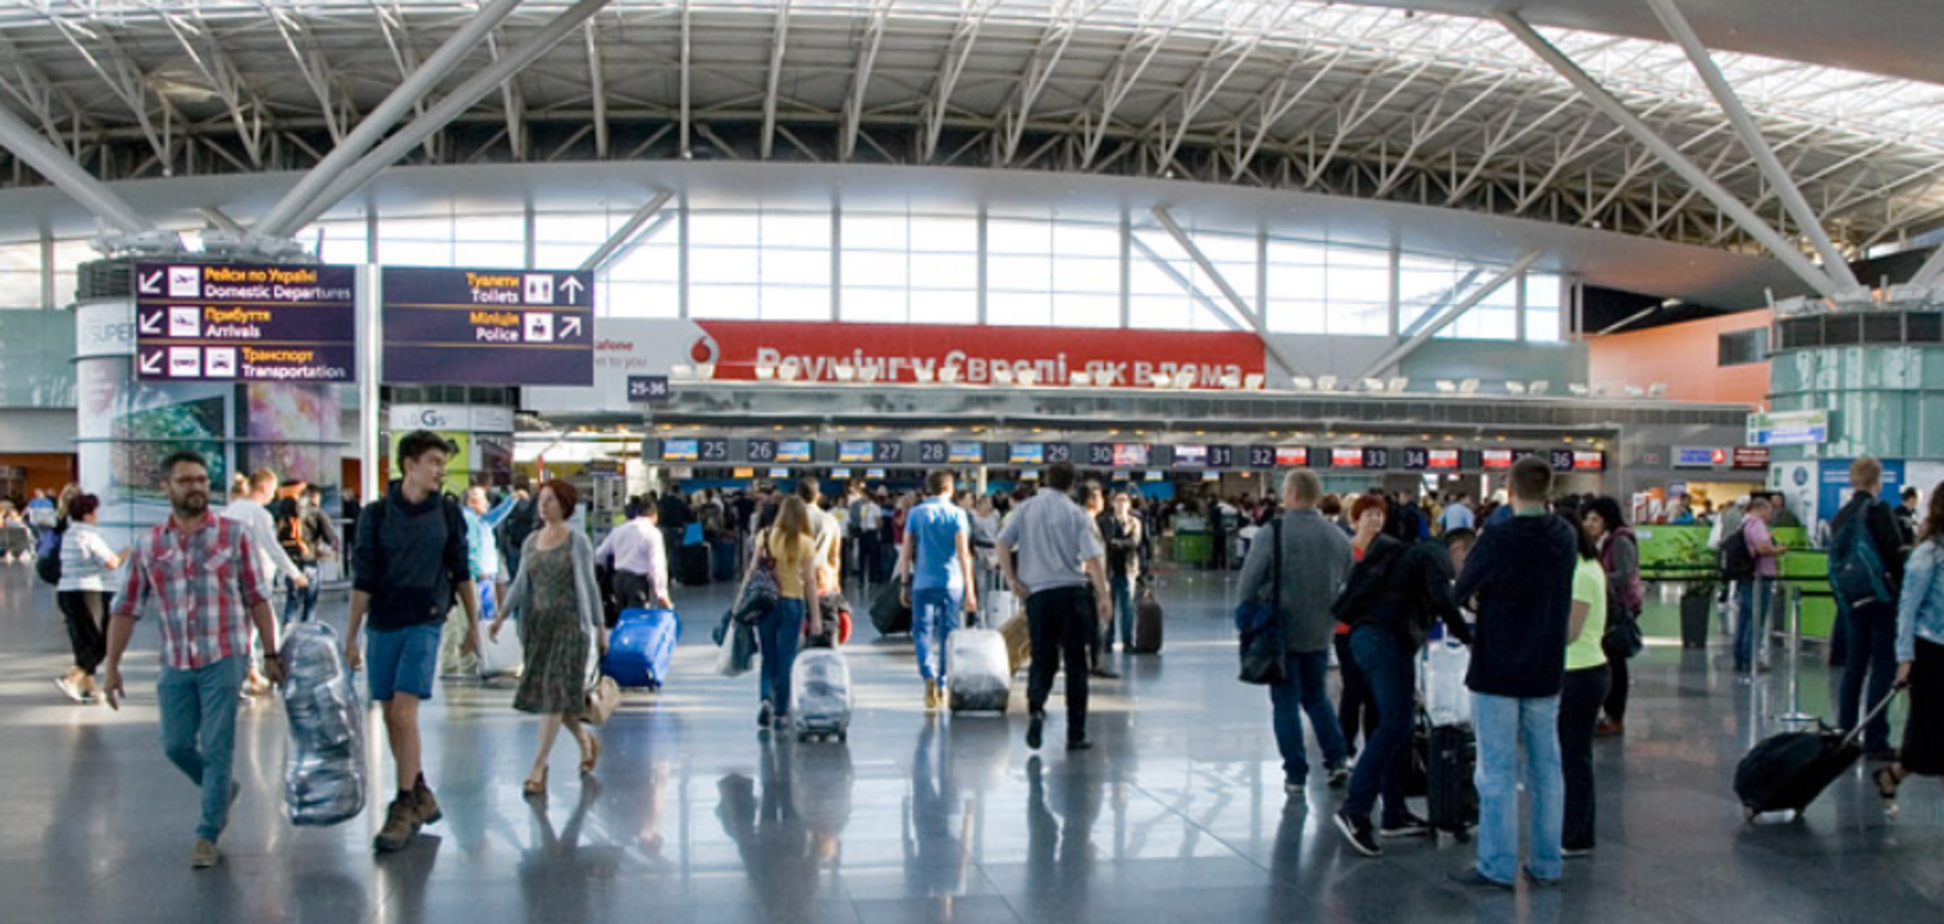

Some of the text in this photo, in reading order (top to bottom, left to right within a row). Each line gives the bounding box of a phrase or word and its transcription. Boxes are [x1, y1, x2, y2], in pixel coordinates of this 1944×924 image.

[205, 267, 317, 284] Рейси по Україні
[466, 272, 519, 289] Туалети
[205, 285, 350, 301] Domestic Departures
[472, 290, 518, 303] Toilets
[205, 307, 271, 323] Прибуття
[205, 325, 261, 338] Arrivals
[476, 327, 518, 342] Police
[242, 347, 314, 364] Транспорт
[242, 365, 346, 380] Transportation
[631, 380, 666, 396] 25-36
[703, 441, 725, 458] 25
[749, 441, 772, 458] 26
[879, 443, 900, 460] 27
[922, 443, 944, 460] 28
[1048, 445, 1069, 462] 29
[1091, 445, 1112, 462] 30
[1213, 449, 1231, 464] 31
[1252, 449, 1272, 464] 32
[1367, 450, 1386, 465] 33
[1405, 450, 1425, 466] 34
[1552, 452, 1570, 466] 36
